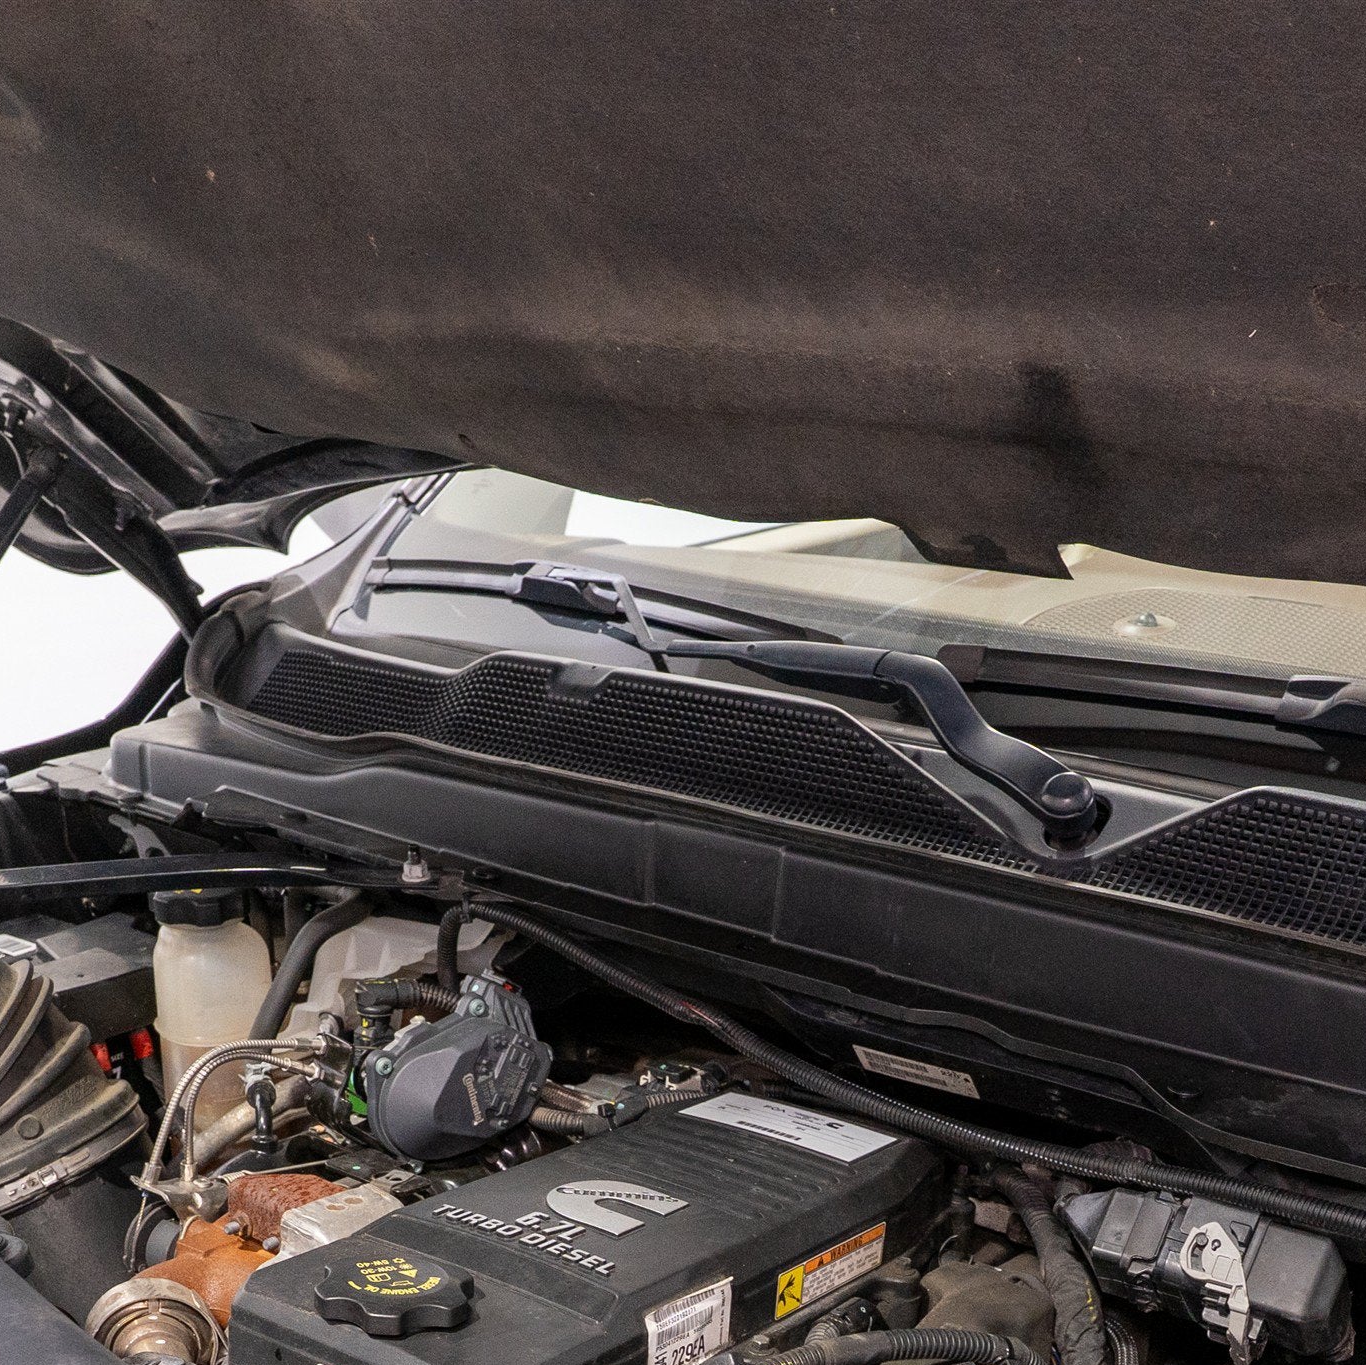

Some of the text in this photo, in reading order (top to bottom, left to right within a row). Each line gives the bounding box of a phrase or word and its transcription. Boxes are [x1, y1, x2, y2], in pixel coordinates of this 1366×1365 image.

[462, 1073, 485, 1126] Continental
[555, 1187, 680, 1204] Cummins
[432, 1203, 617, 1277] TURBO DIESEL
[515, 1212, 586, 1242] 6.7L
